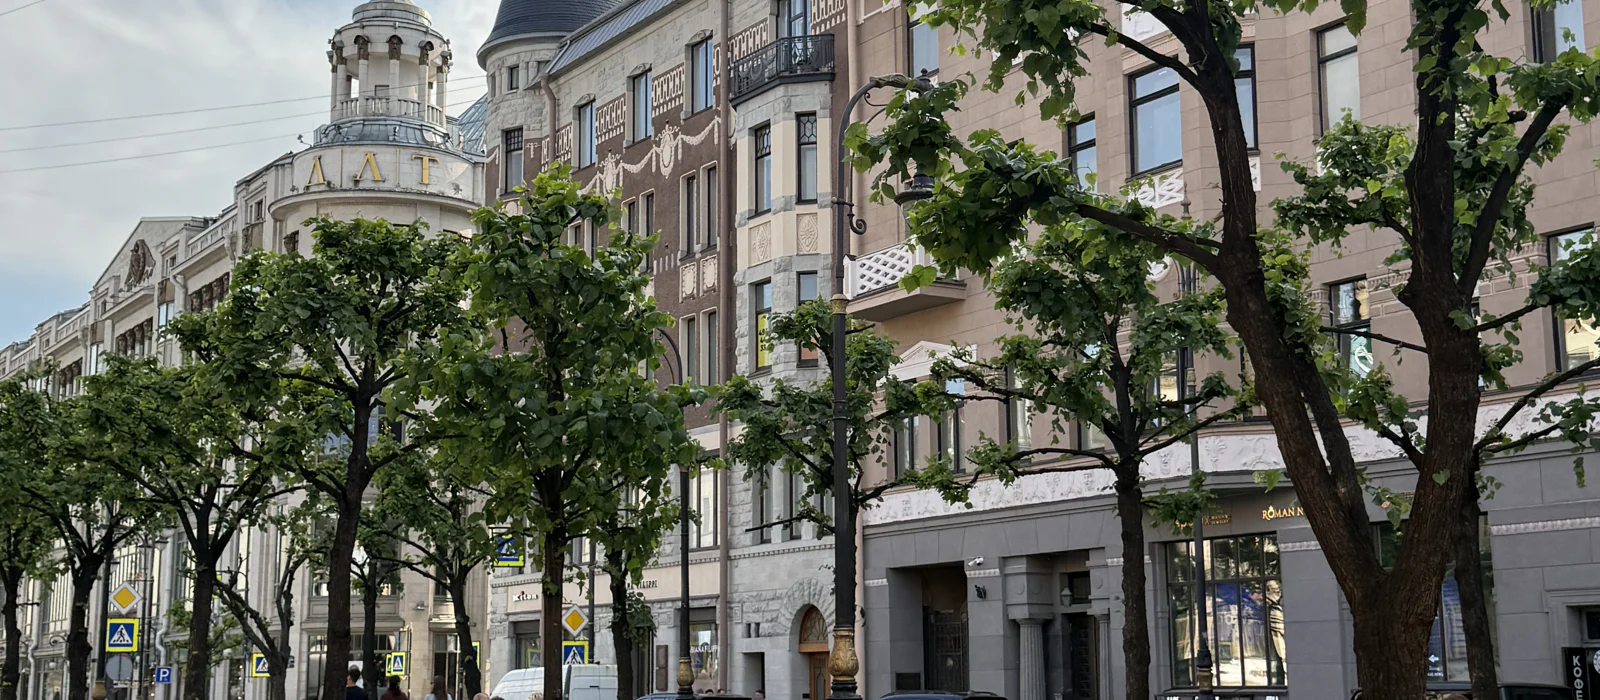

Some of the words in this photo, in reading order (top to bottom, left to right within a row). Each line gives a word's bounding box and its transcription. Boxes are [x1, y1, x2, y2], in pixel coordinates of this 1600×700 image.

[1261, 505, 1295, 521] ROMAN
[512, 590, 539, 602] Kiton
[160, 668, 170, 682] P
[1573, 655, 1584, 700] КОФЕ
